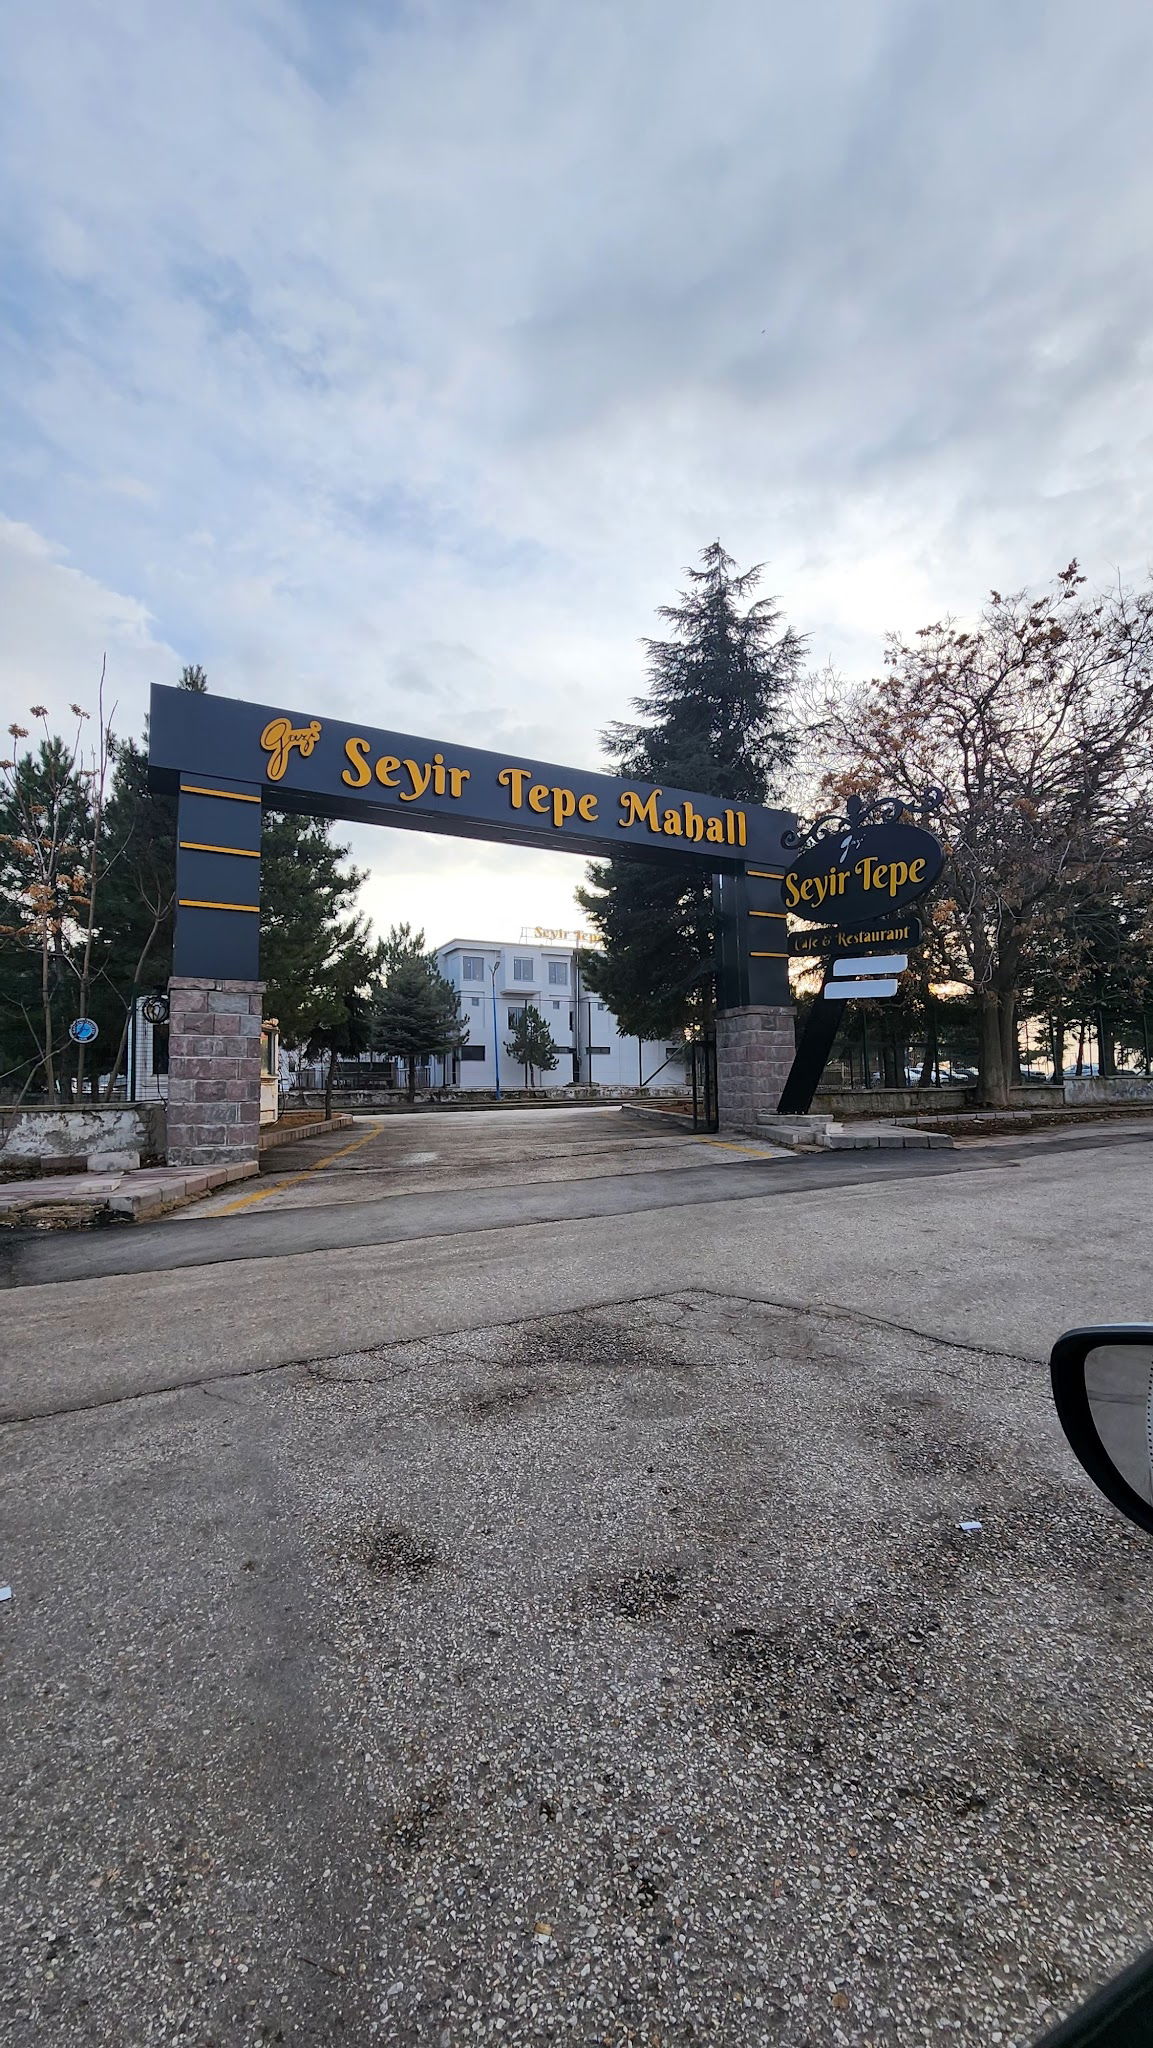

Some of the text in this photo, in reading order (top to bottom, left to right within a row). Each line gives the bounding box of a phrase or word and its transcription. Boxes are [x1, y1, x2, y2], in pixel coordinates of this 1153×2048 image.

[342, 738, 471, 801] Seyir
[498, 768, 599, 827] Tepe
[619, 789, 747, 847] Mahall
[785, 856, 926, 909] Seyir Tepe
[534, 926, 568, 940] Seyir
[823, 931, 831, 947] &
[837, 926, 910, 947] Restaurant
